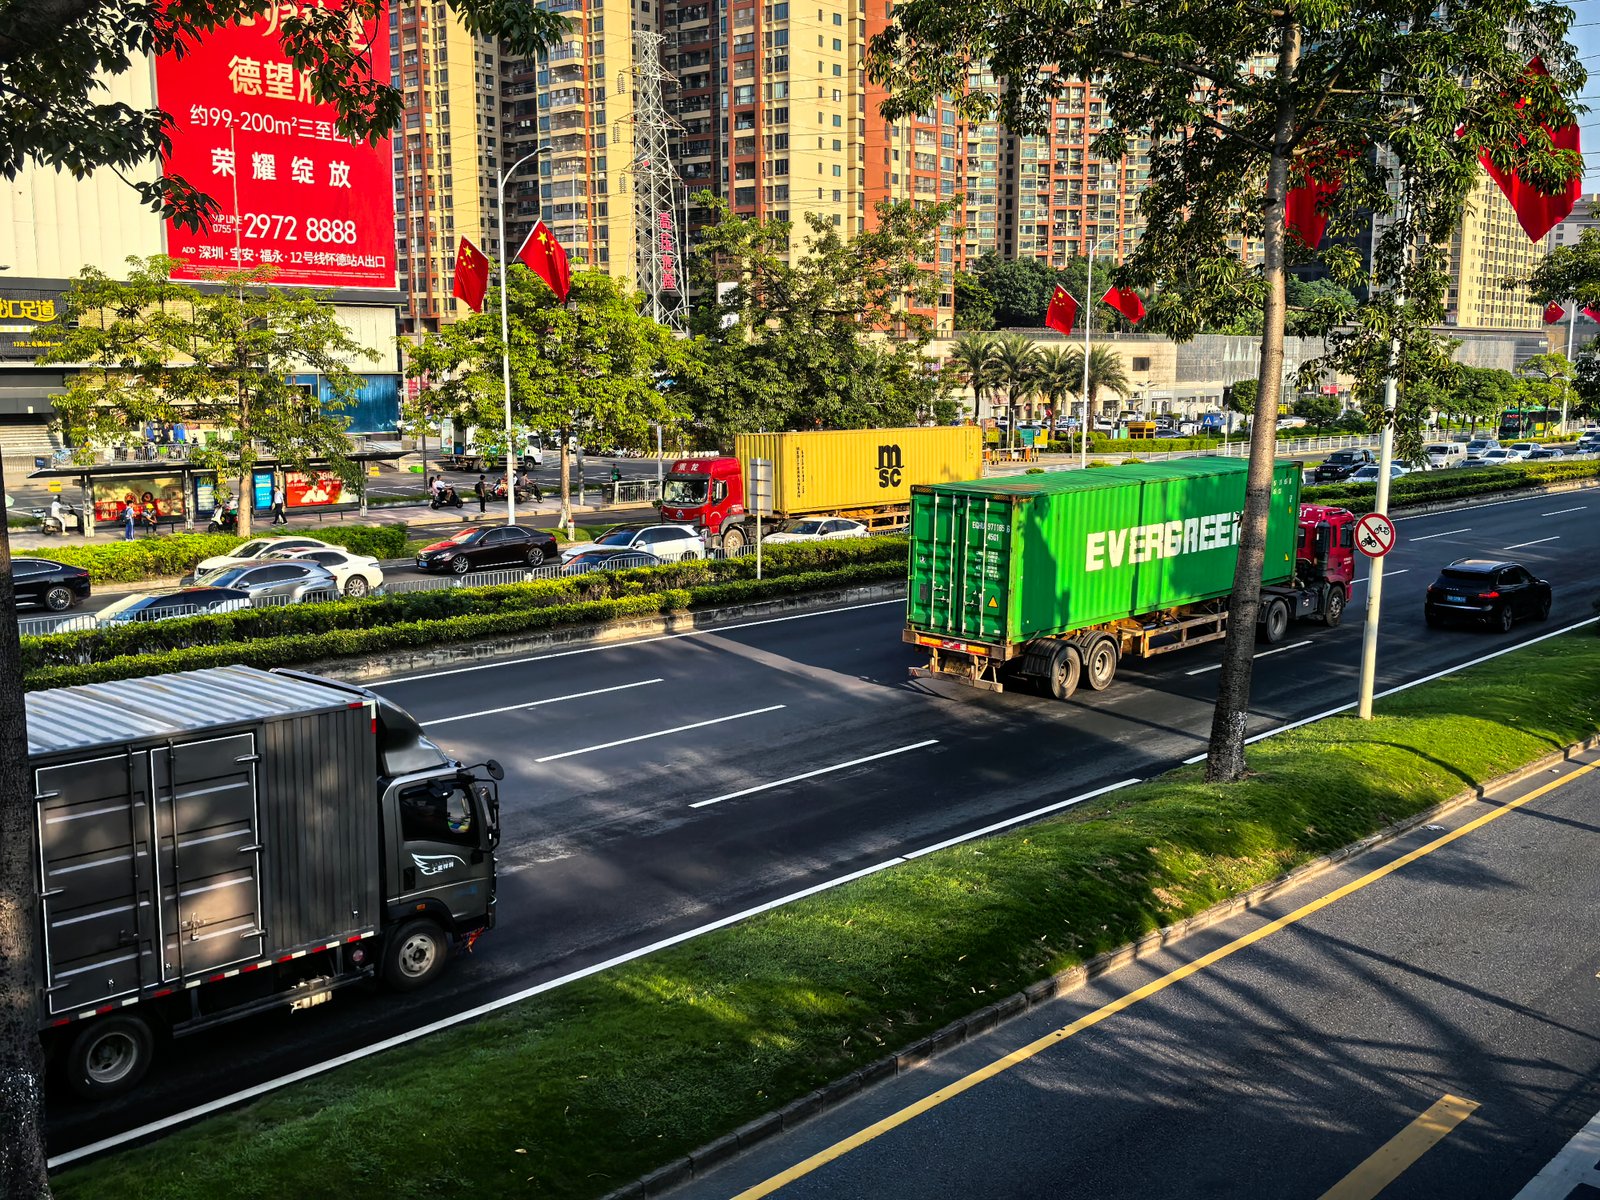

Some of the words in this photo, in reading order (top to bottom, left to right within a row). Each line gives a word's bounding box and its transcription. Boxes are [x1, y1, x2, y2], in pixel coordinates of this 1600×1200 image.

[210, 147, 353, 189] 荣耀绽放
[225, 215, 243, 225] LINE
[243, 212, 298, 241] 2972
[305, 217, 357, 245] 8888
[181, 246, 196, 255] ADD
[0, 298, 59, 322] 汇足道
